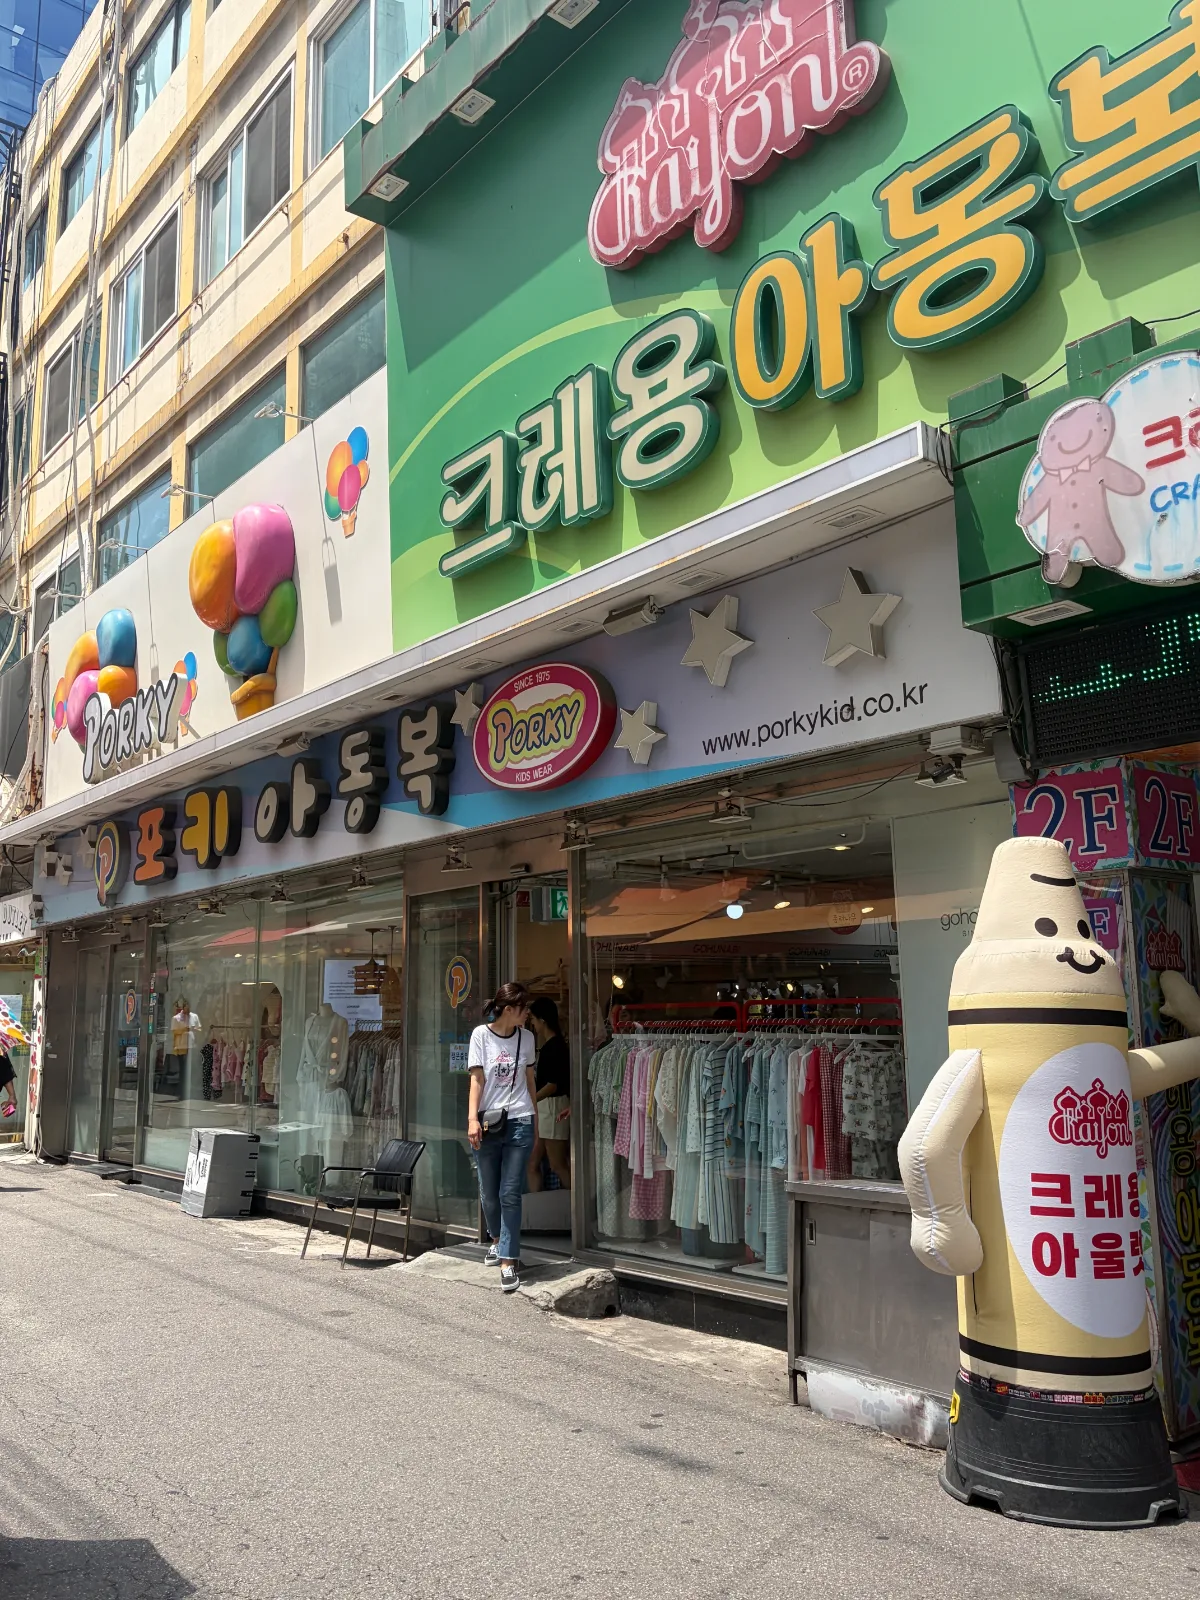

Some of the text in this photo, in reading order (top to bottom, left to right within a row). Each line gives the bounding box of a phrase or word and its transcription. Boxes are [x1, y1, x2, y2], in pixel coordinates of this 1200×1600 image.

[439, 308, 724, 577] 크레용
[513, 670, 551, 693] SINCE 1975
[83, 673, 180, 784] PORKY
[491, 699, 581, 764] PORKY
[701, 682, 929, 756] www.porkykid.co.kr
[134, 704, 448, 885] 포키 아동복
[515, 764, 553, 783] KIDS WEAR
[1019, 784, 1120, 856] 2F
[1145, 778, 1195, 856] 2F
